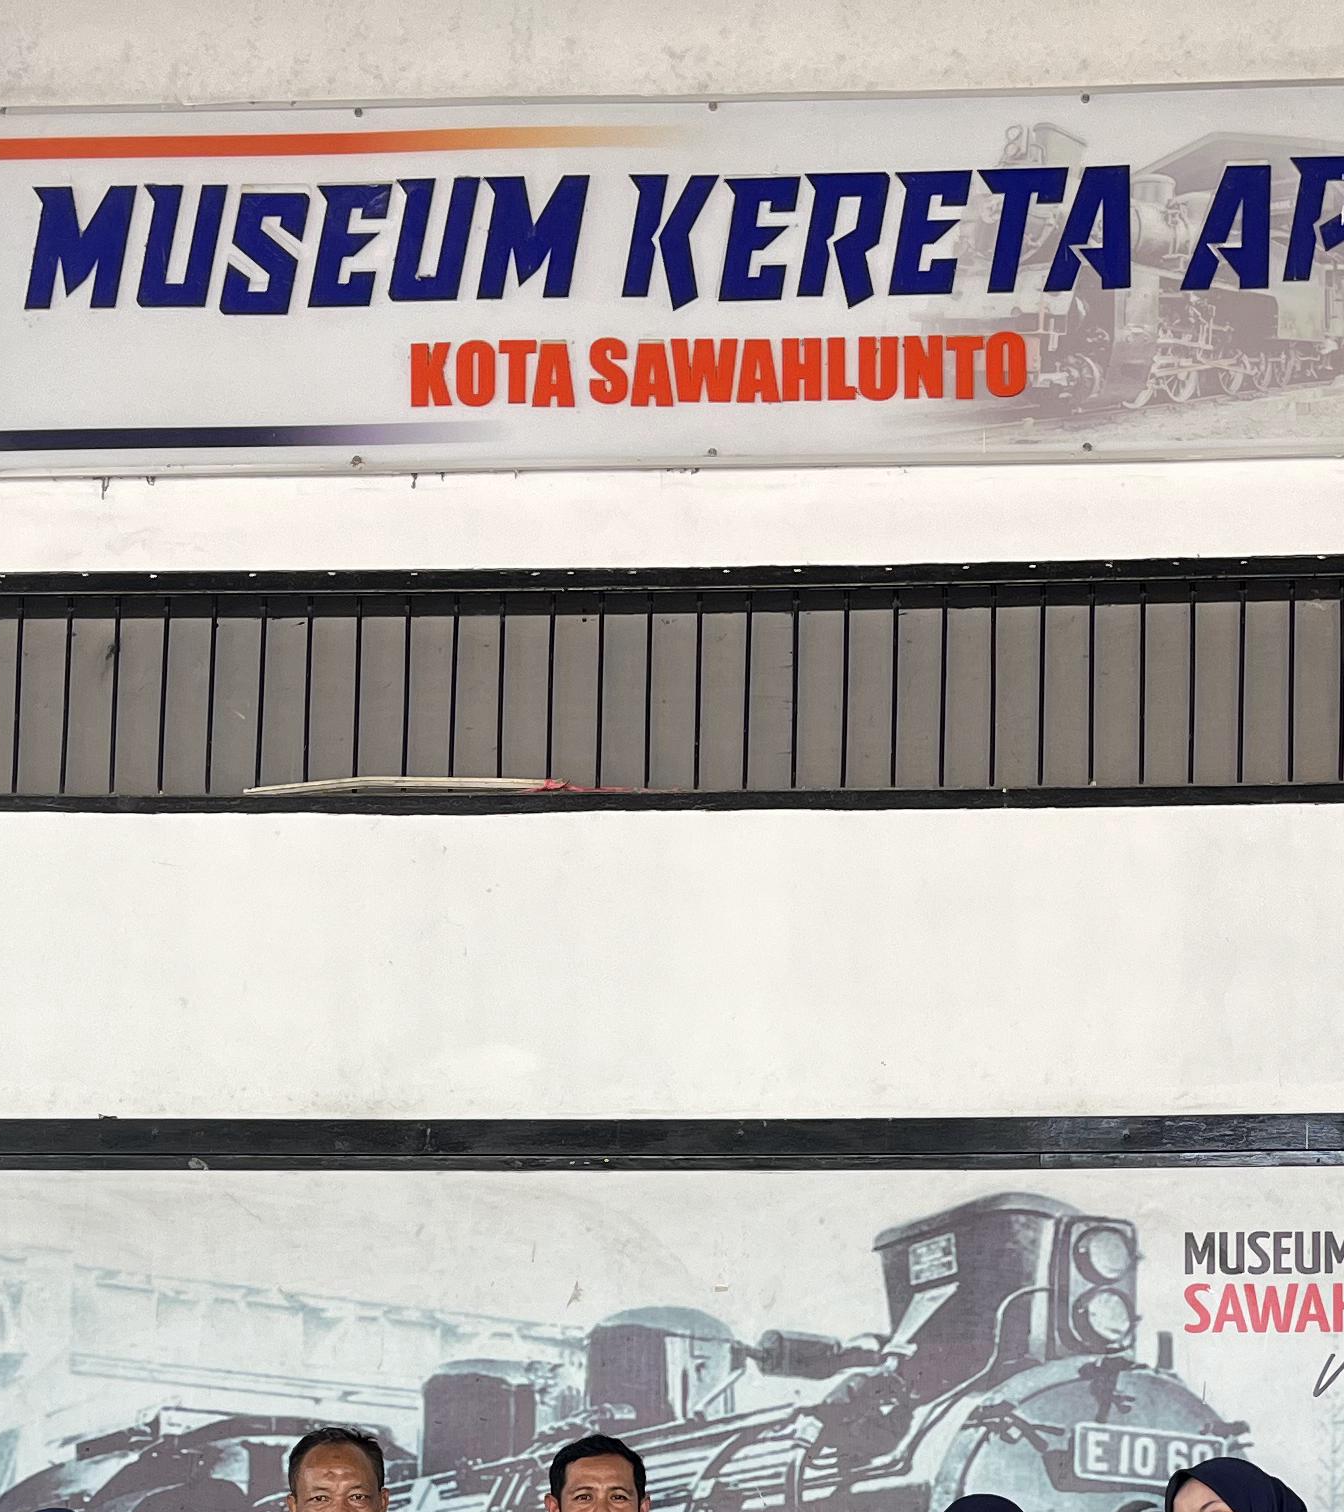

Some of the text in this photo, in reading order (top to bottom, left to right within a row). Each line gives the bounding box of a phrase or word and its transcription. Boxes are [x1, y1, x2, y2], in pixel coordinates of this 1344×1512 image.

[23, 174, 590, 315] MUSEUM
[622, 164, 1131, 311] KERETA
[410, 331, 1027, 407] KOTA SAWAHLUNTO
